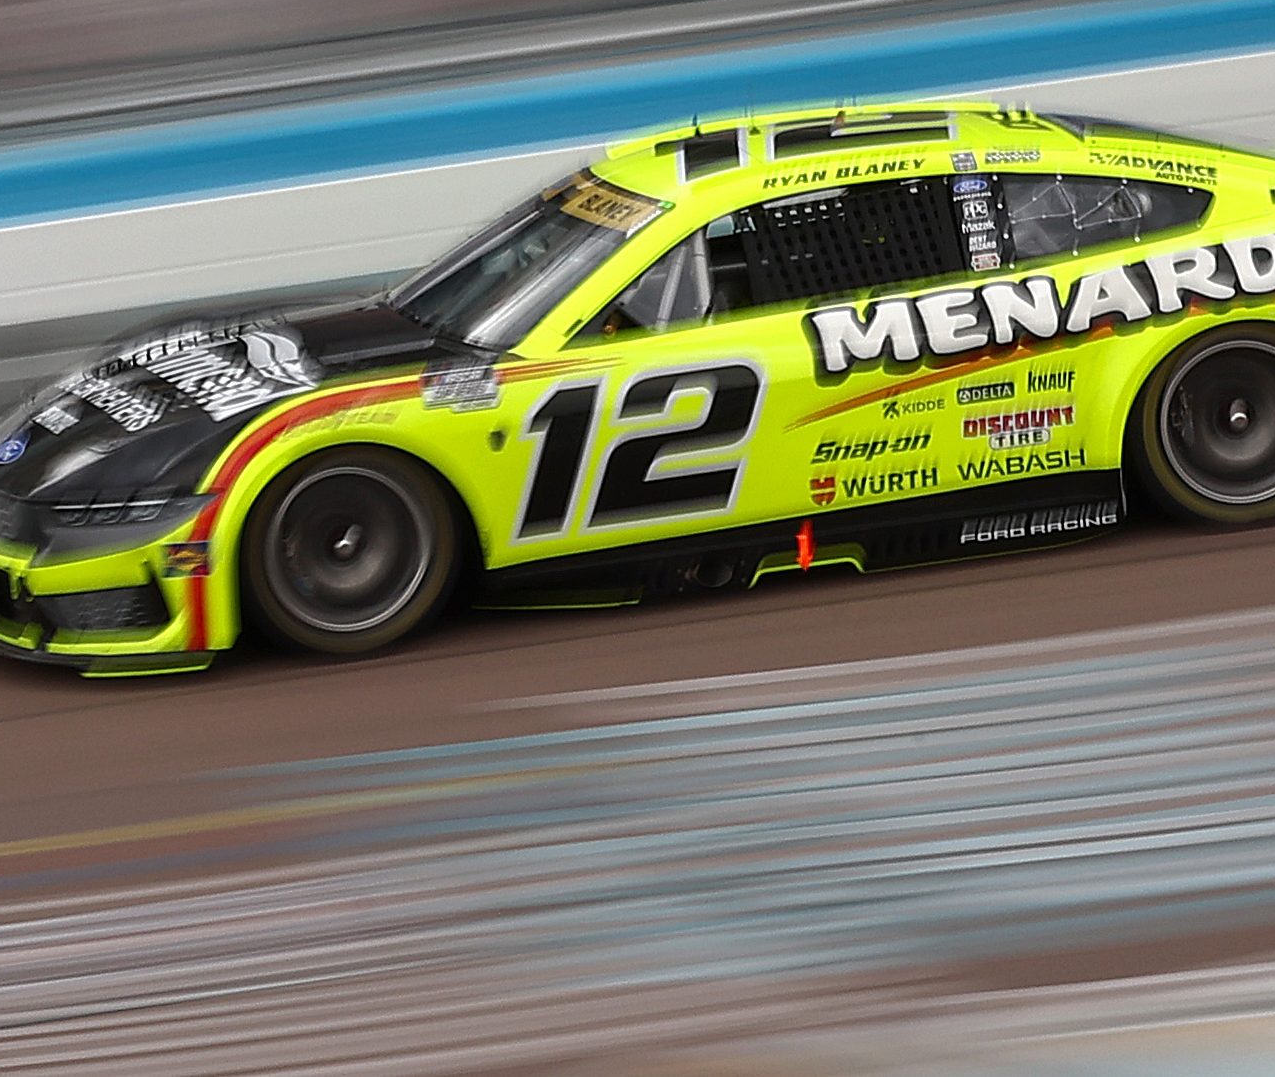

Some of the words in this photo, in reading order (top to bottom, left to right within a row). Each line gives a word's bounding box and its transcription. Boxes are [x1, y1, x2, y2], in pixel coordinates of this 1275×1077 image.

[762, 172, 827, 189] RYAN
[835, 158, 927, 180] BLANEY
[1115, 154, 1218, 178] ADVANCE
[1156, 171, 1185, 182] AUTO
[1186, 175, 1218, 186] PARTS
[577, 193, 641, 222] BLANEY
[961, 220, 996, 234] Mazak
[971, 385, 1012, 400] DELTA
[1027, 371, 1076, 393] KNAUF
[901, 399, 945, 414] KIDDE
[962, 405, 1076, 438] DISCOUNT
[514, 361, 763, 541] 12
[810, 433, 932, 464] Snap-on
[995, 431, 1044, 446] TIRE
[957, 448, 1087, 481] WABASH
[842, 468, 939, 499] WÜRTH
[960, 527, 1026, 544] FORD
[1030, 514, 1117, 537] RACING
